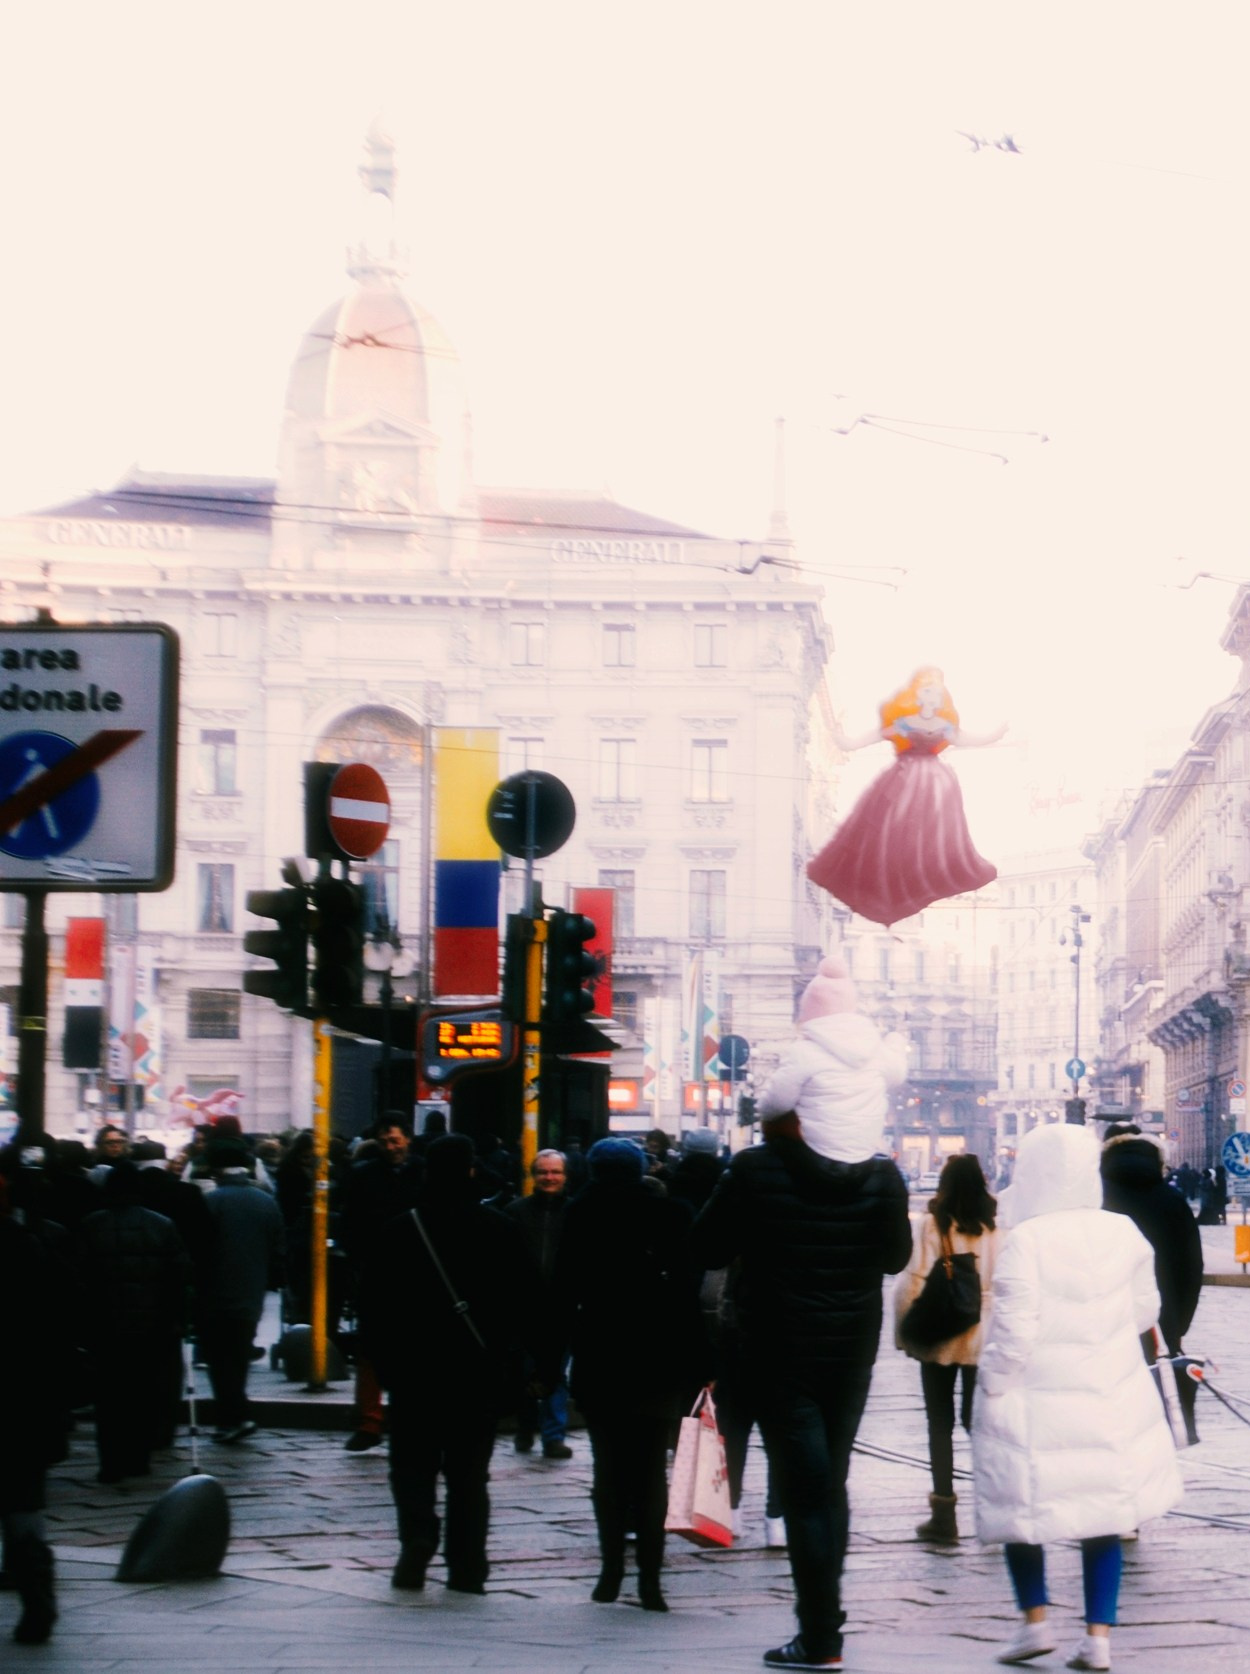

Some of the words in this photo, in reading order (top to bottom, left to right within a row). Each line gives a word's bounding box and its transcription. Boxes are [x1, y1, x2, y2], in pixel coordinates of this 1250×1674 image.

[550, 539, 686, 564] GENERALI
[1, 647, 81, 671] area
[0, 684, 123, 712] donale
